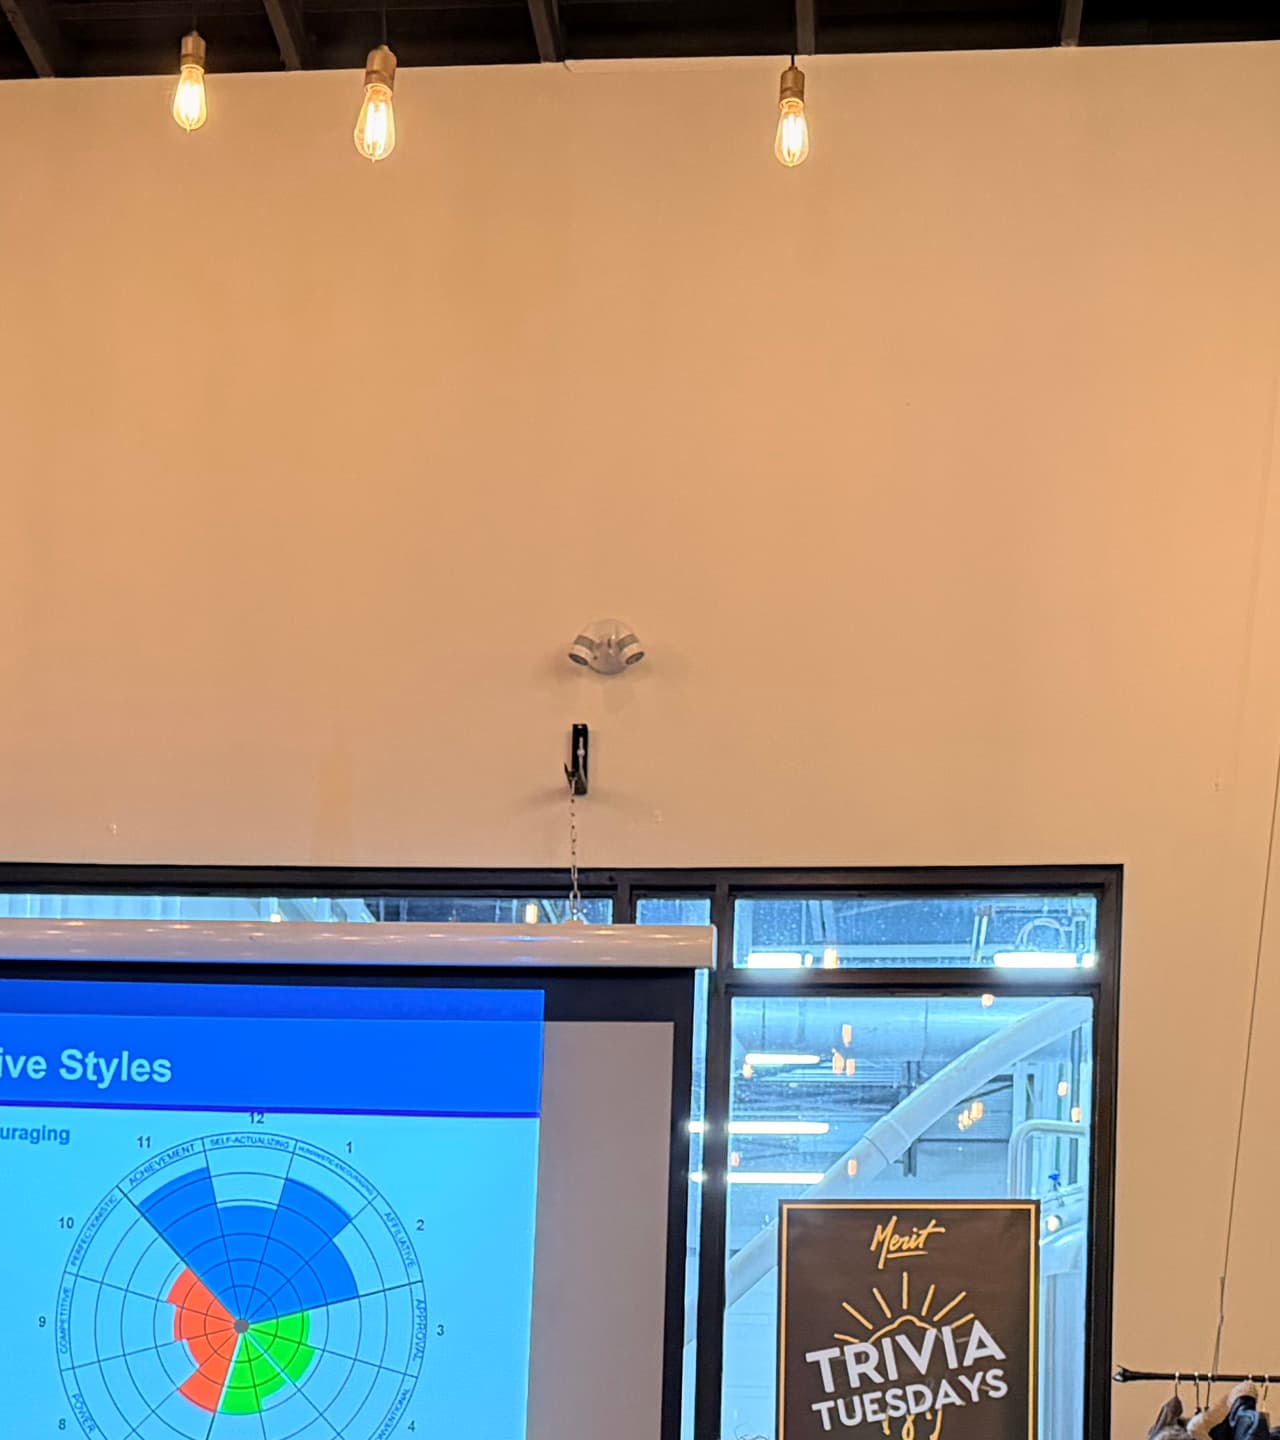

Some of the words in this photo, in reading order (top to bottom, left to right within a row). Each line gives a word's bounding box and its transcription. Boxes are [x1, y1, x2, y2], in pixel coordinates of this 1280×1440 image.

[58, 1048, 173, 1089] Styles
[248, 1110, 265, 1124] 12
[136, 1135, 152, 1149] 11
[209, 1135, 290, 1150] SELF-ACTUALIZING
[345, 1141, 353, 1154] 1
[128, 1143, 196, 1186] ACHIEVEMENT
[58, 1216, 74, 1229] 10
[70, 1193, 119, 1267] PERFECTIONISTIC
[416, 1219, 425, 1231] 2
[383, 1211, 417, 1270] AFFILIATIVE
[869, 1215, 946, 1270] Merit
[38, 1316, 47, 1328] 9
[59, 1286, 72, 1354] COMPETITIVE
[412, 1298, 427, 1362] APPROVAL
[436, 1324, 445, 1336] 3
[805, 1319, 1007, 1394] TRIVIA
[71, 1392, 97, 1434] POWER
[811, 1367, 1009, 1432] TUESDAYS
[58, 1418, 67, 1431] 8
[407, 1420, 416, 1432] 4
